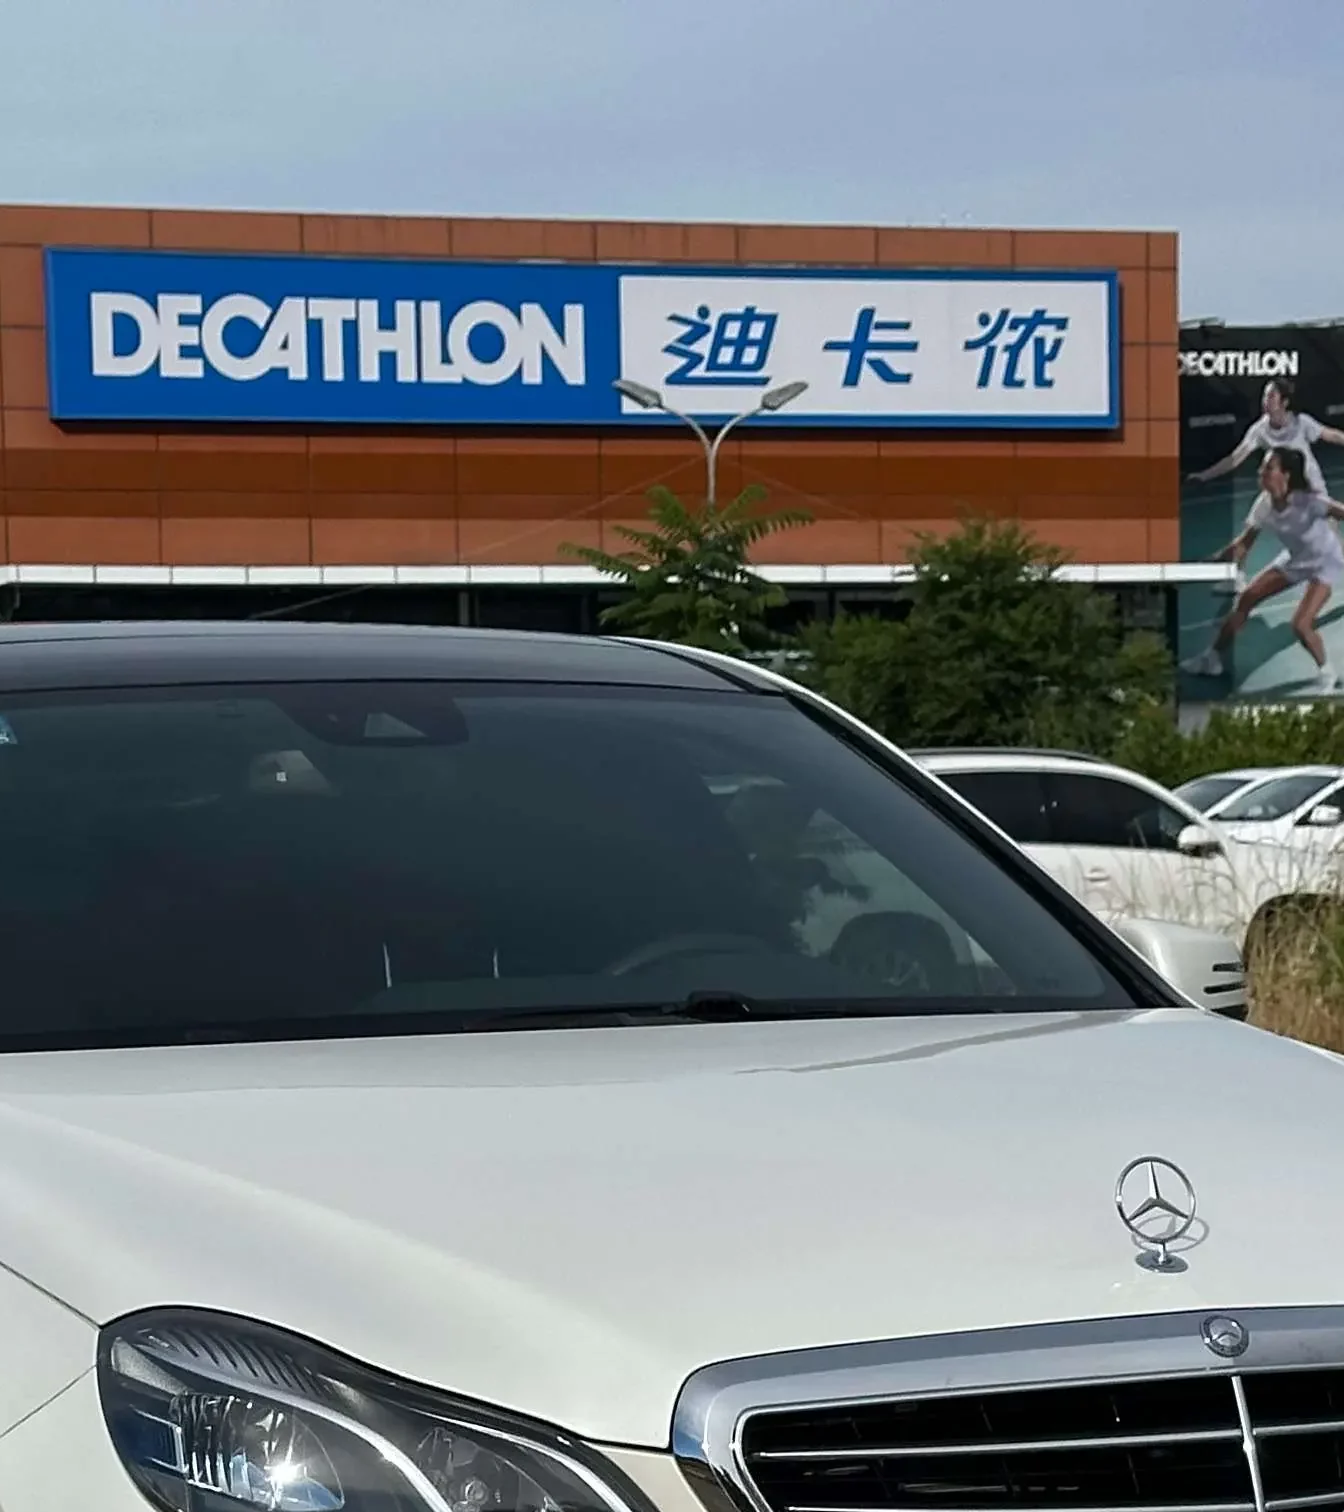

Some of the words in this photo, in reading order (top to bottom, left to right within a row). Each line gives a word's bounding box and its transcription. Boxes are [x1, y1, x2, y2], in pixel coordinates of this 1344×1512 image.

[89, 291, 586, 387] DECATHLON
[662, 305, 1070, 389] 迪卡侬
